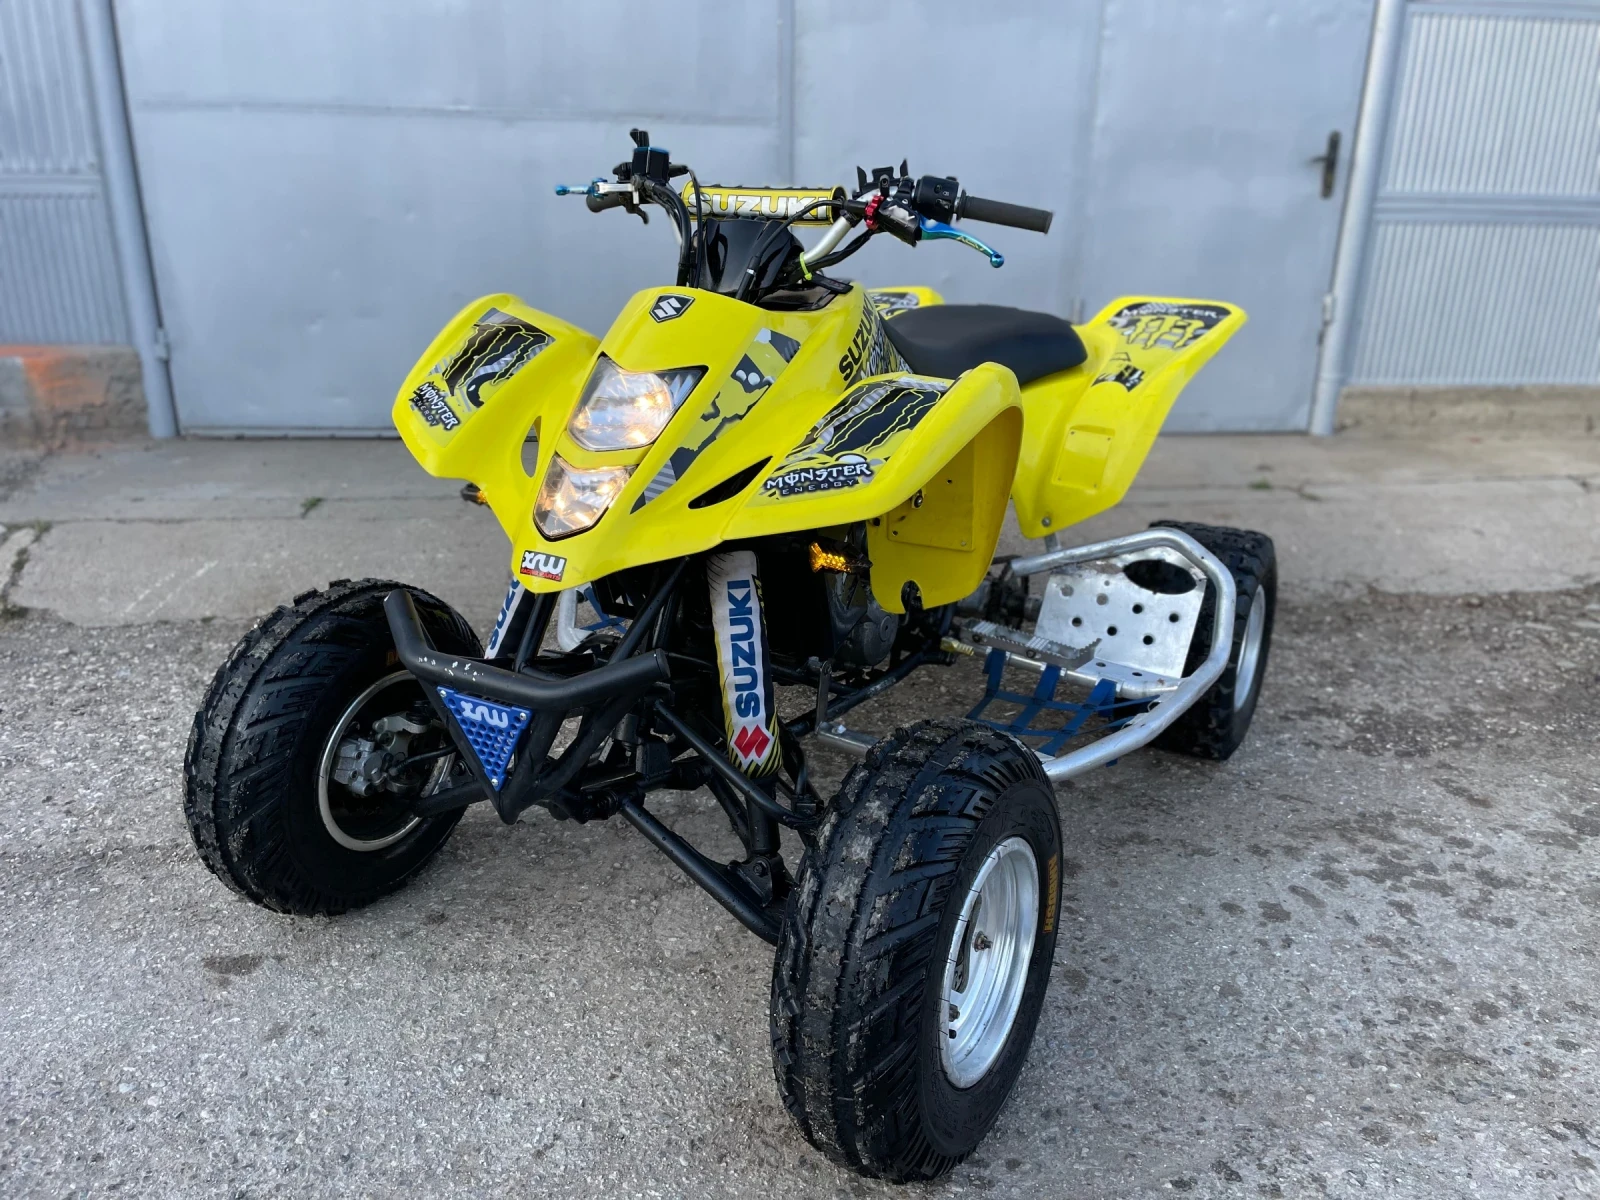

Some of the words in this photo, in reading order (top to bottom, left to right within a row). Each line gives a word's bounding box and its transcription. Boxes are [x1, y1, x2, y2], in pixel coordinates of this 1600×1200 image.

[687, 193, 829, 220] SUZUKI
[1121, 308, 1218, 319] MONSTER
[413, 396, 437, 425] ENERGY
[419, 383, 459, 429] MONSTER
[766, 463, 872, 490] MONSTER
[782, 479, 855, 495] ENERGY
[727, 579, 760, 718] SUZUKI
[1044, 854, 1058, 933] AMBUSH
